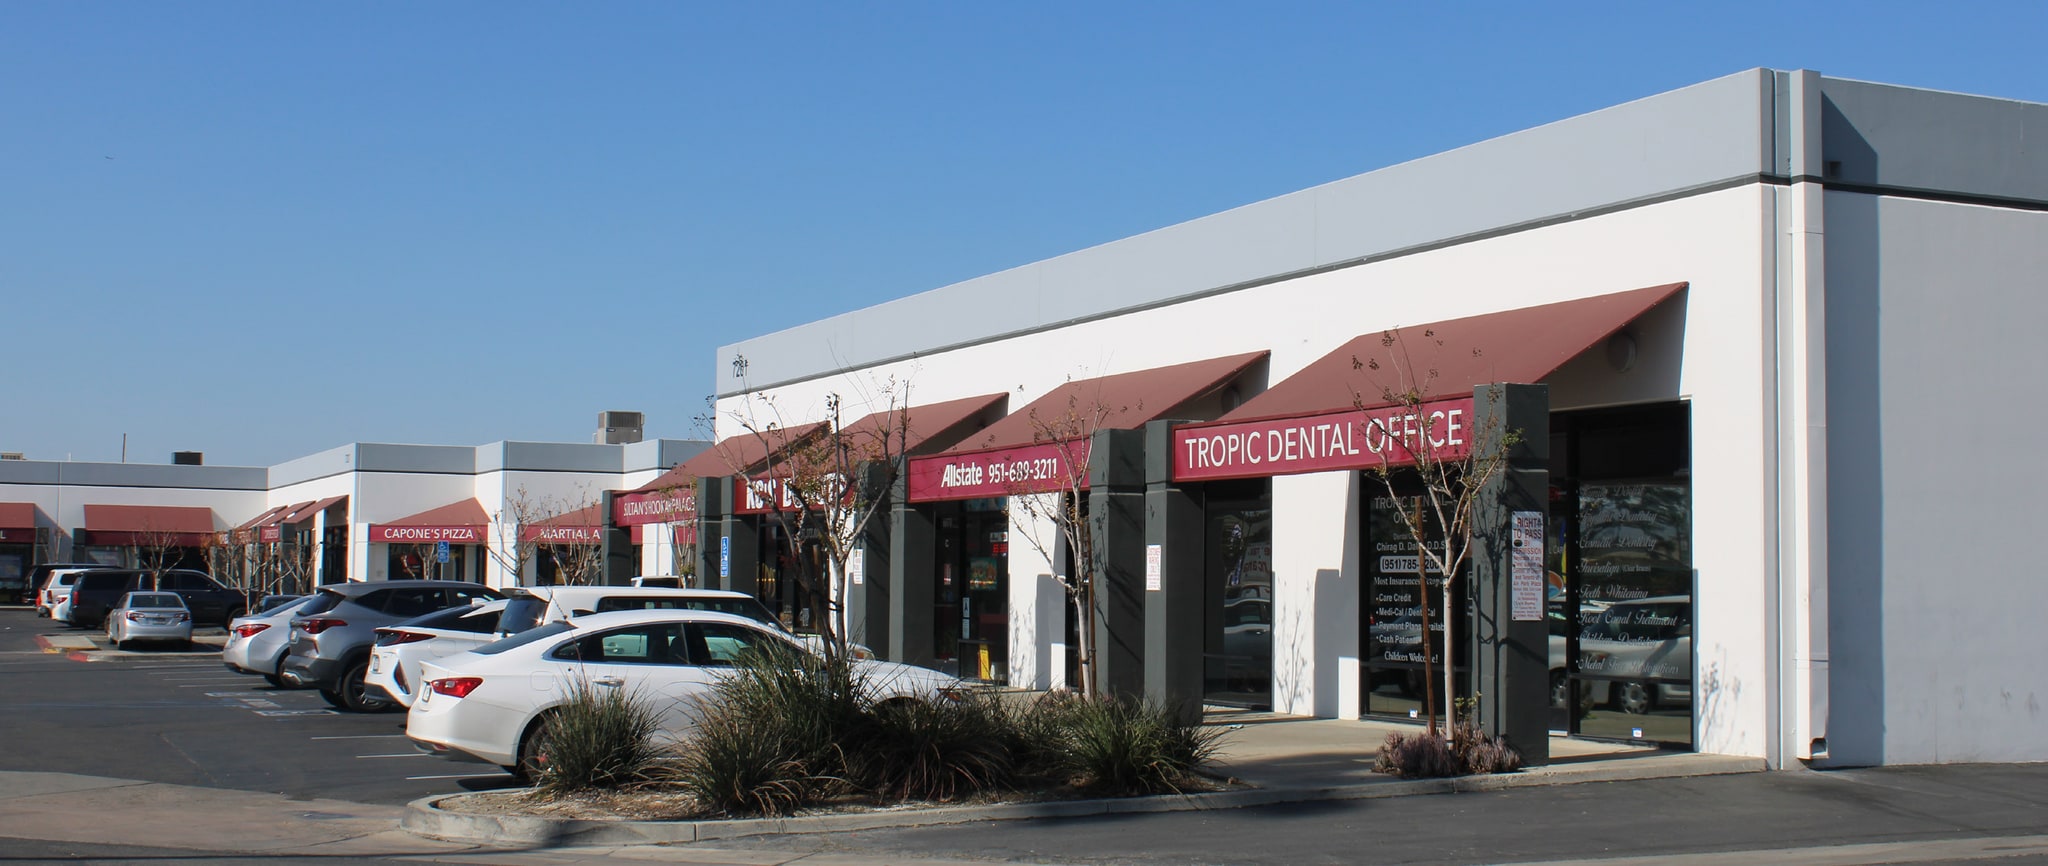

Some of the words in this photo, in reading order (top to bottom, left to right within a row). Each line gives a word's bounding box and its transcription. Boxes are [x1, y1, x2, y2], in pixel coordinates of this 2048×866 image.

[1185, 431, 1261, 469] TROPIC
[1267, 422, 1359, 463] DENTAL
[1366, 409, 1463, 454] OFFICE
[941, 462, 983, 488] Allstate
[988, 458, 1057, 484] 951-689-3211
[384, 528, 440, 539] CAPONE'S
[443, 529, 474, 539] PIZZA
[541, 528, 590, 539] MARTIAL
[1513, 529, 1522, 539] TO
[1525, 529, 1542, 540] PASS
[1579, 584, 1601, 598] Teeth
[1606, 584, 1648, 599] Whitening
[1378, 593, 1392, 602] Care
[1394, 593, 1412, 603] Credit
[1604, 609, 1632, 624] Canal
[1634, 609, 1678, 626] Treatment
[1379, 634, 1394, 643] Cash
[1384, 651, 1408, 662] Children
[1409, 652, 1438, 664] Welcoe!
